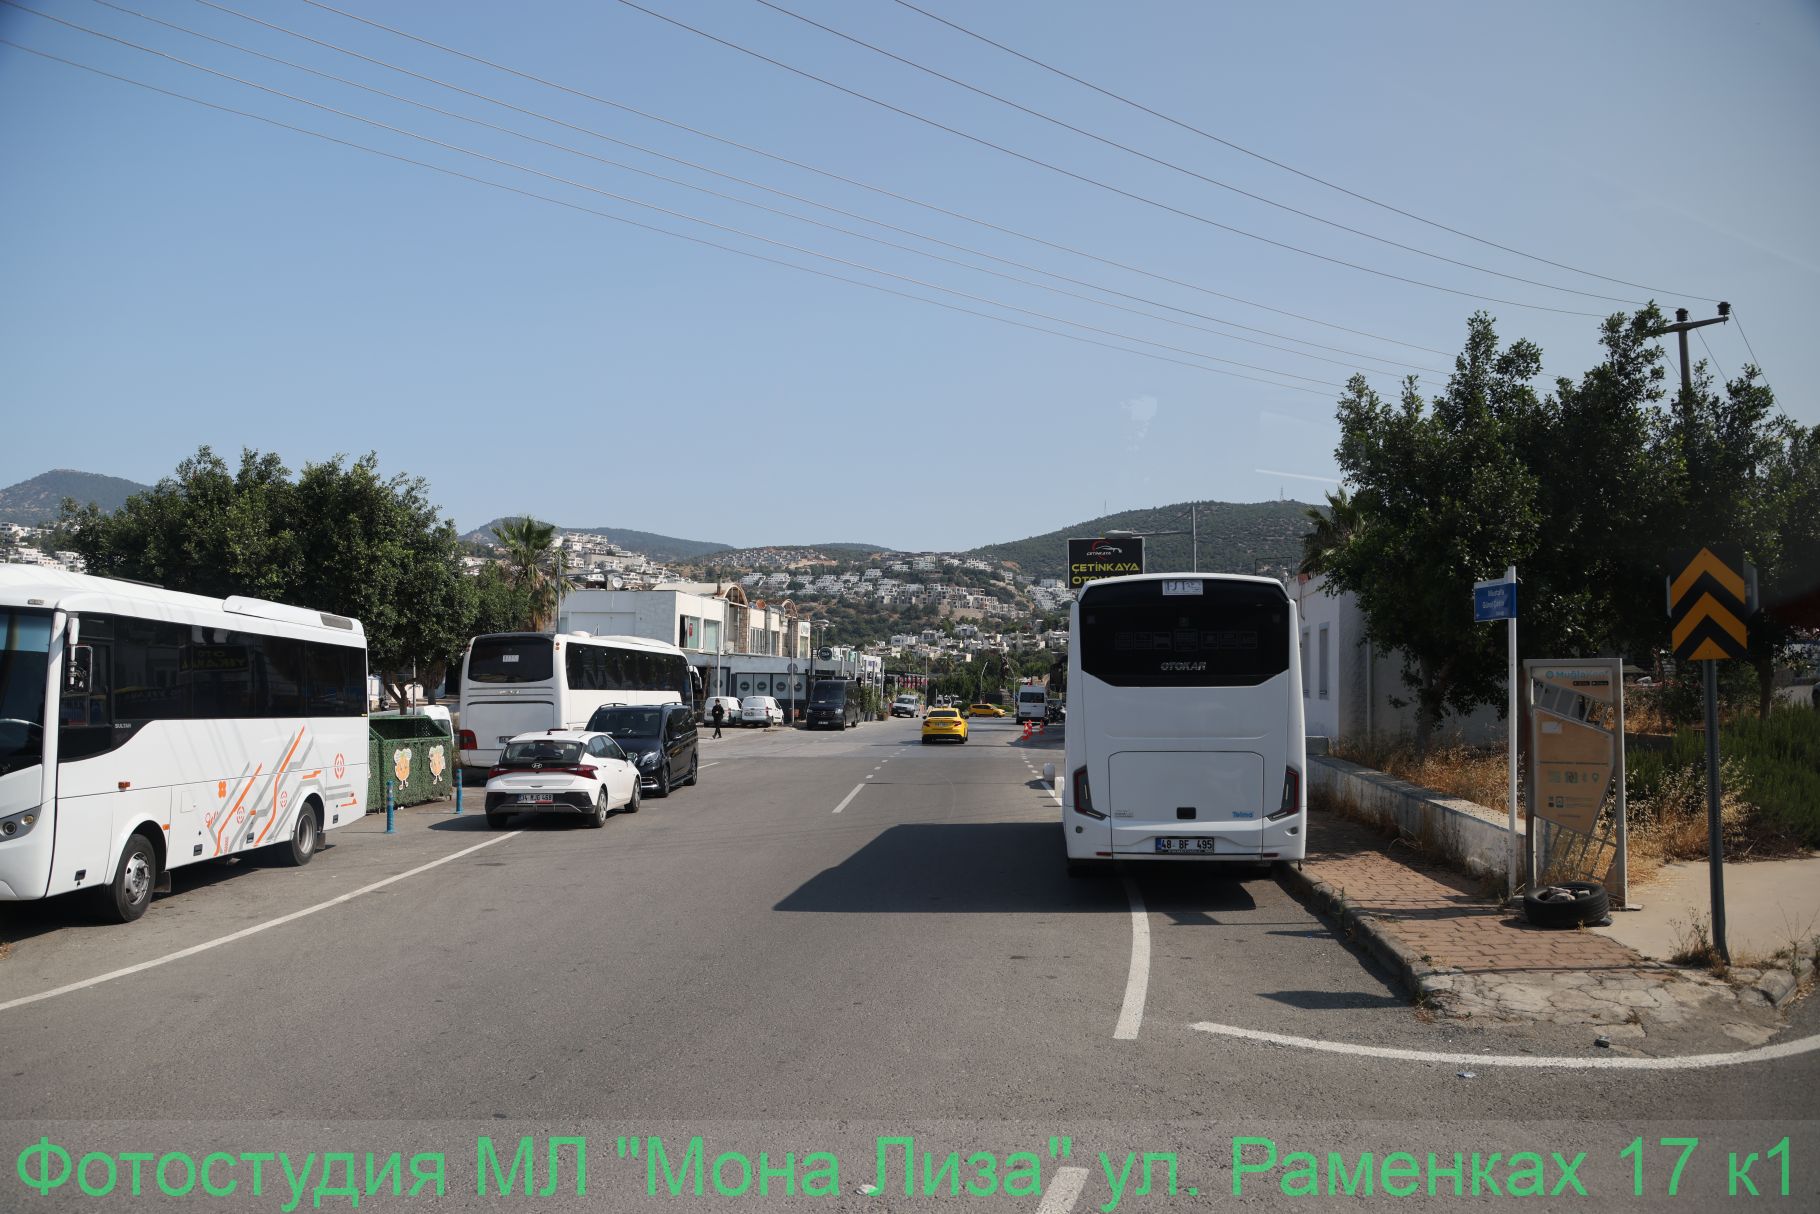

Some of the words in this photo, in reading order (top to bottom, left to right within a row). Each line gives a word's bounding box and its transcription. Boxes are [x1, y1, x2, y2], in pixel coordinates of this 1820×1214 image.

[1071, 562, 1139, 574] ÇETİNKAYA
[1160, 661, 1206, 671] OTOKAR
[1161, 839, 1172, 849] 48
[1178, 839, 1190, 849] BF
[1196, 839, 1213, 849] 495
